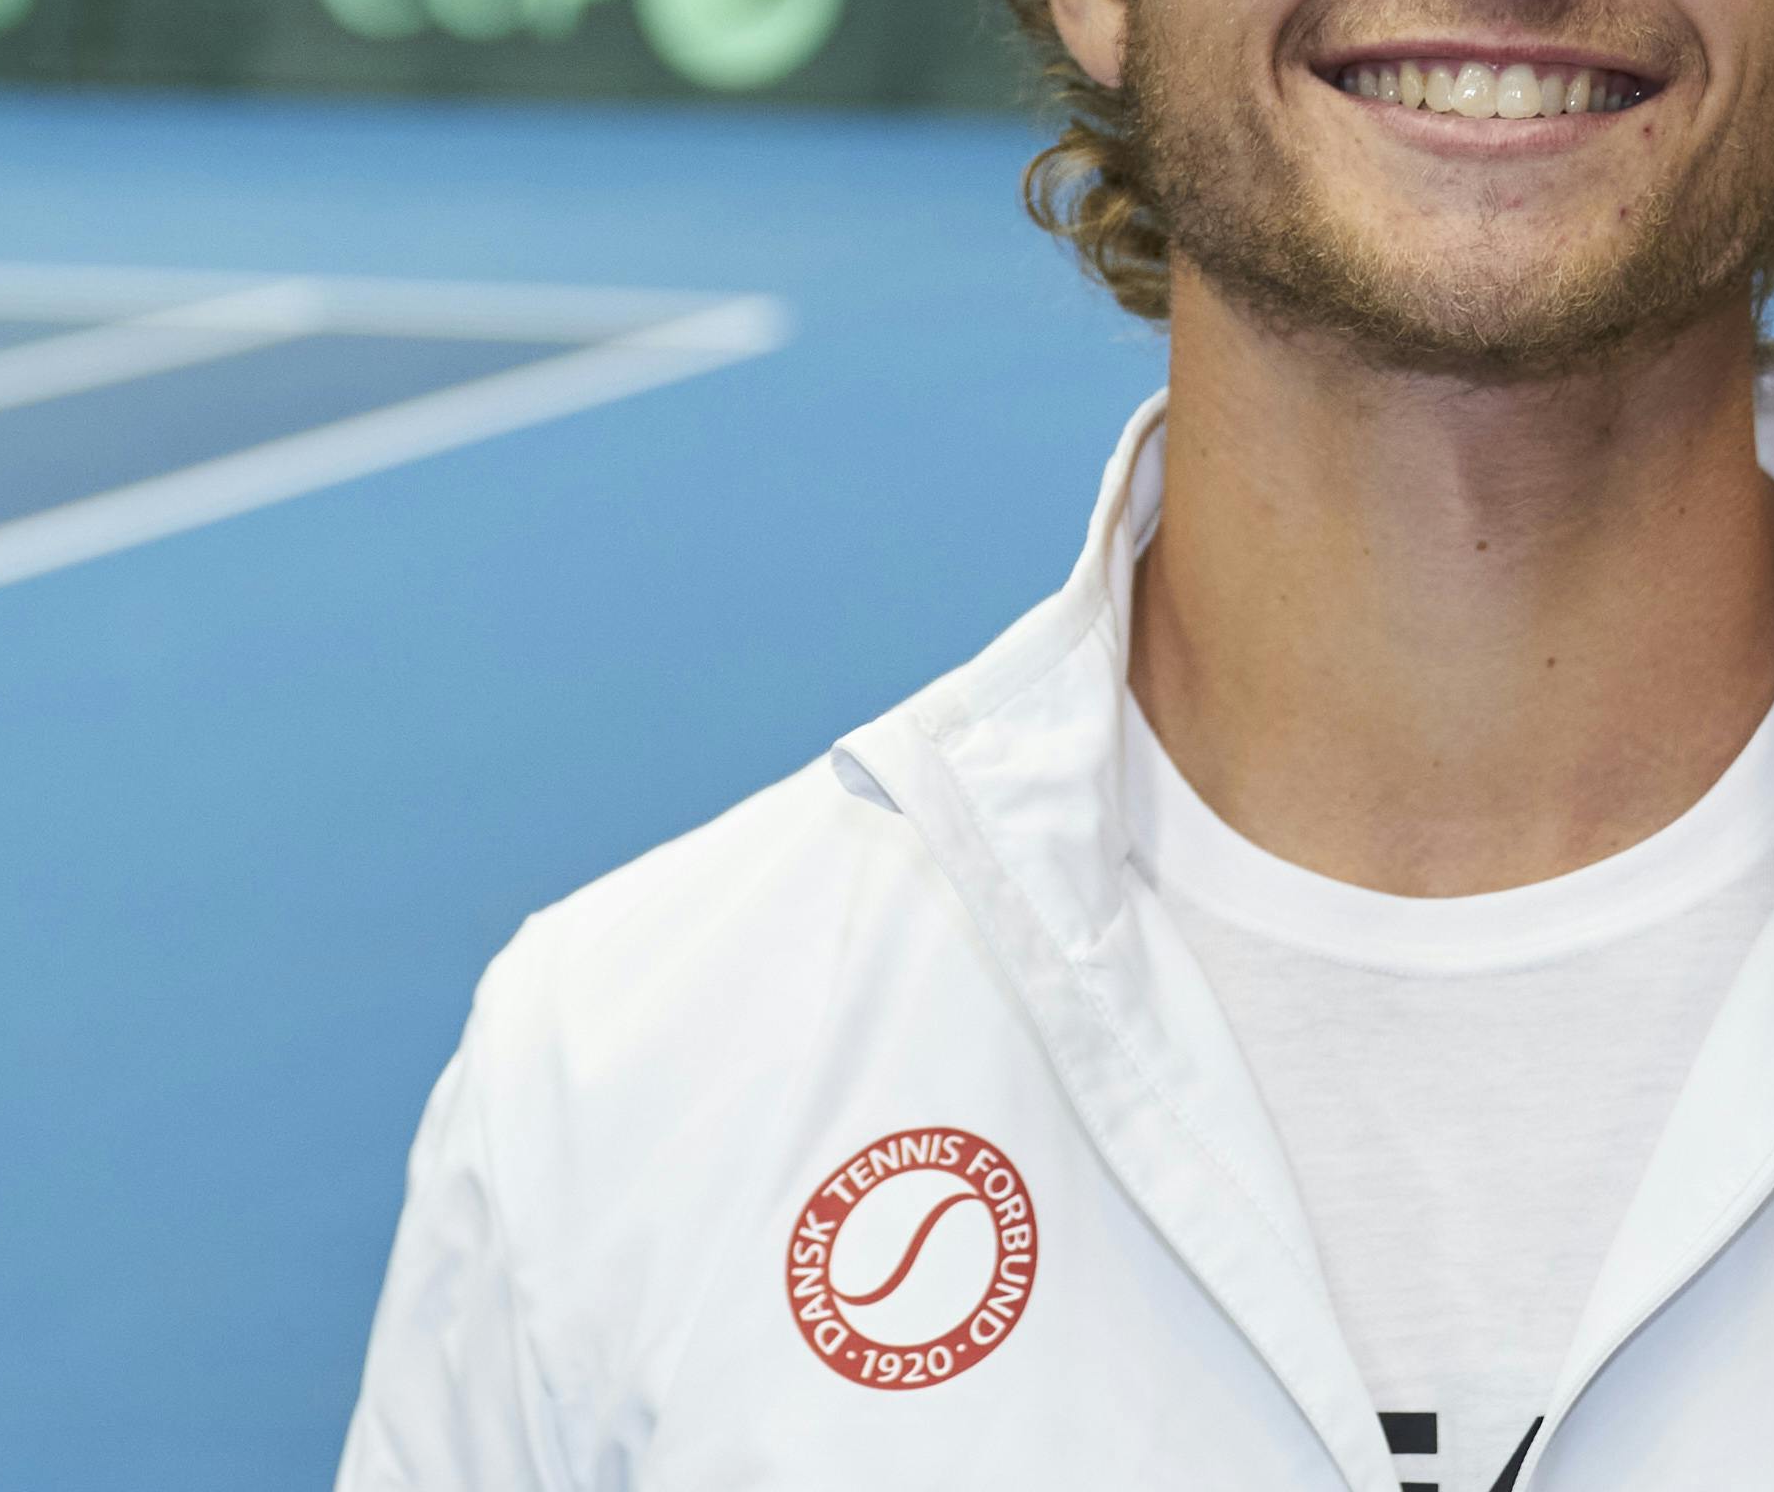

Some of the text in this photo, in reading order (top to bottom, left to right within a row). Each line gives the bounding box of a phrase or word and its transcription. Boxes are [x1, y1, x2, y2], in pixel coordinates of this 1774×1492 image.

[791, 1133, 1032, 1356] DANSK TENNIS FORBUND
[859, 1345, 954, 1384] 1920
